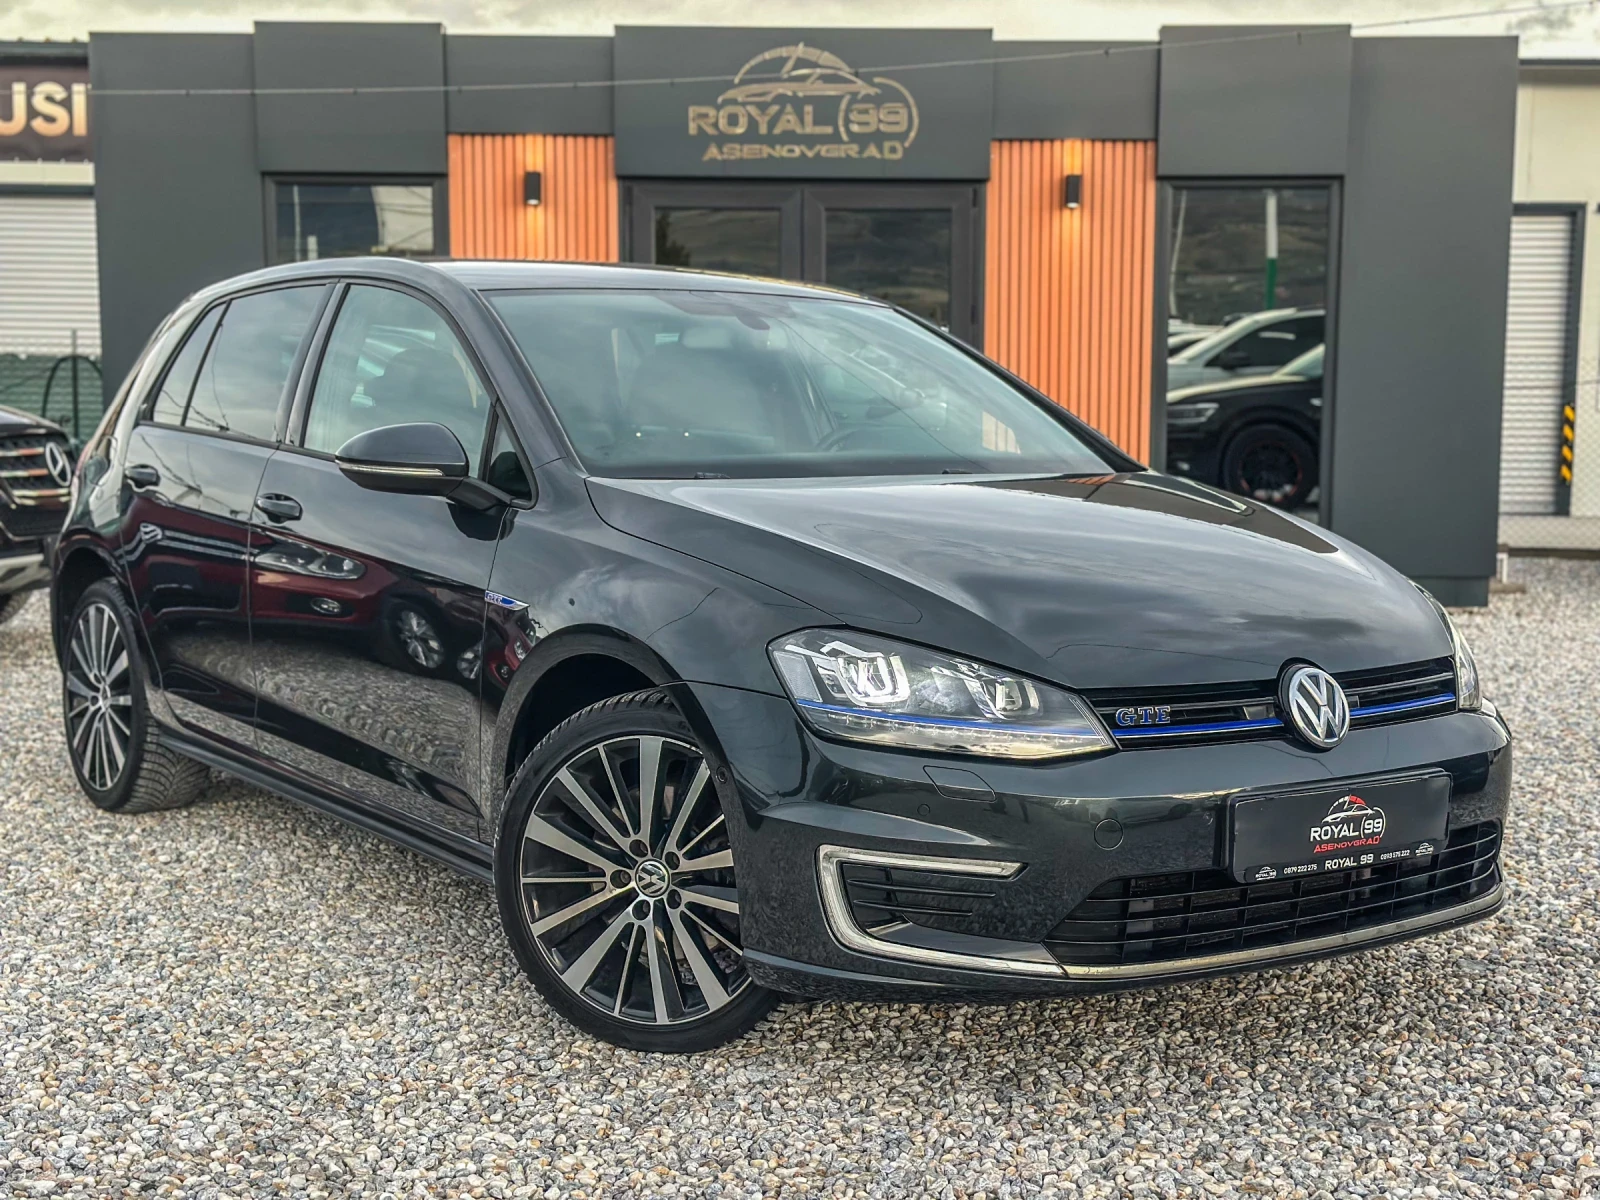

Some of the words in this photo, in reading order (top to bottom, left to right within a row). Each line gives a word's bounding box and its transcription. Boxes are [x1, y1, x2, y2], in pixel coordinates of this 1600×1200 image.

[688, 104, 833, 135] ROYAL
[702, 141, 904, 161] ASENOVGRAD
[1116, 705, 1171, 726] GTE
[1310, 823, 1359, 841] ROYAL
[1313, 836, 1380, 853] ASENOVGRAD
[1325, 857, 1357, 870] ROYAL
[1360, 854, 1374, 865] 99
